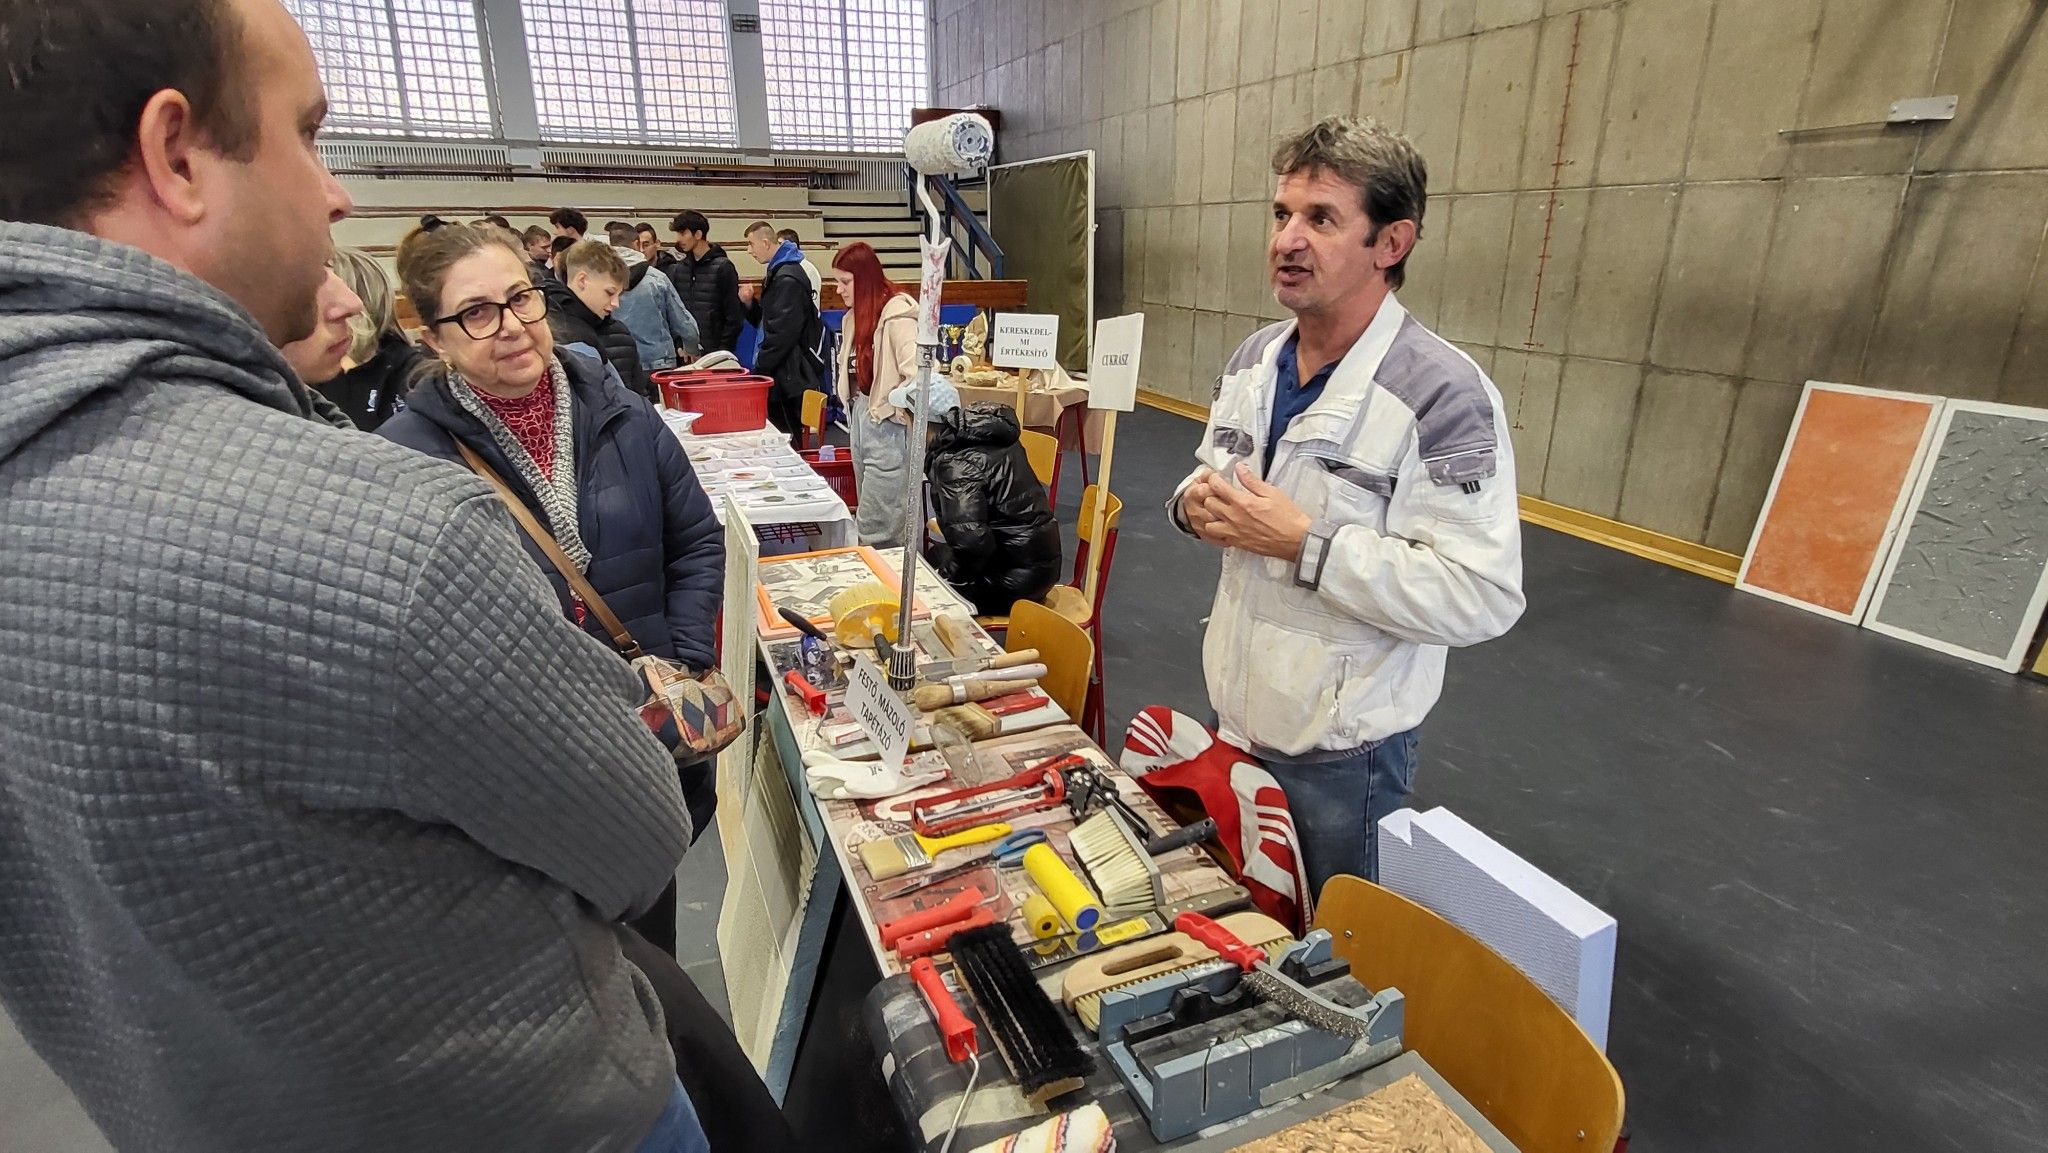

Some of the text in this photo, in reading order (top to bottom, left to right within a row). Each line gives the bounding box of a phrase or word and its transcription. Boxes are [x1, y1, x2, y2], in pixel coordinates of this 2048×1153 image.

[1000, 326, 1052, 336] KERESKEDEL-
[1000, 346, 1048, 358] ÉRTÉKESÍTŐ
[1102, 351, 1129, 366] CUKRÁSZ
[858, 668, 906, 742] FESTŐ, MÁZOLÓ,
[860, 702, 891, 751] TAPÉTÁZÓ
